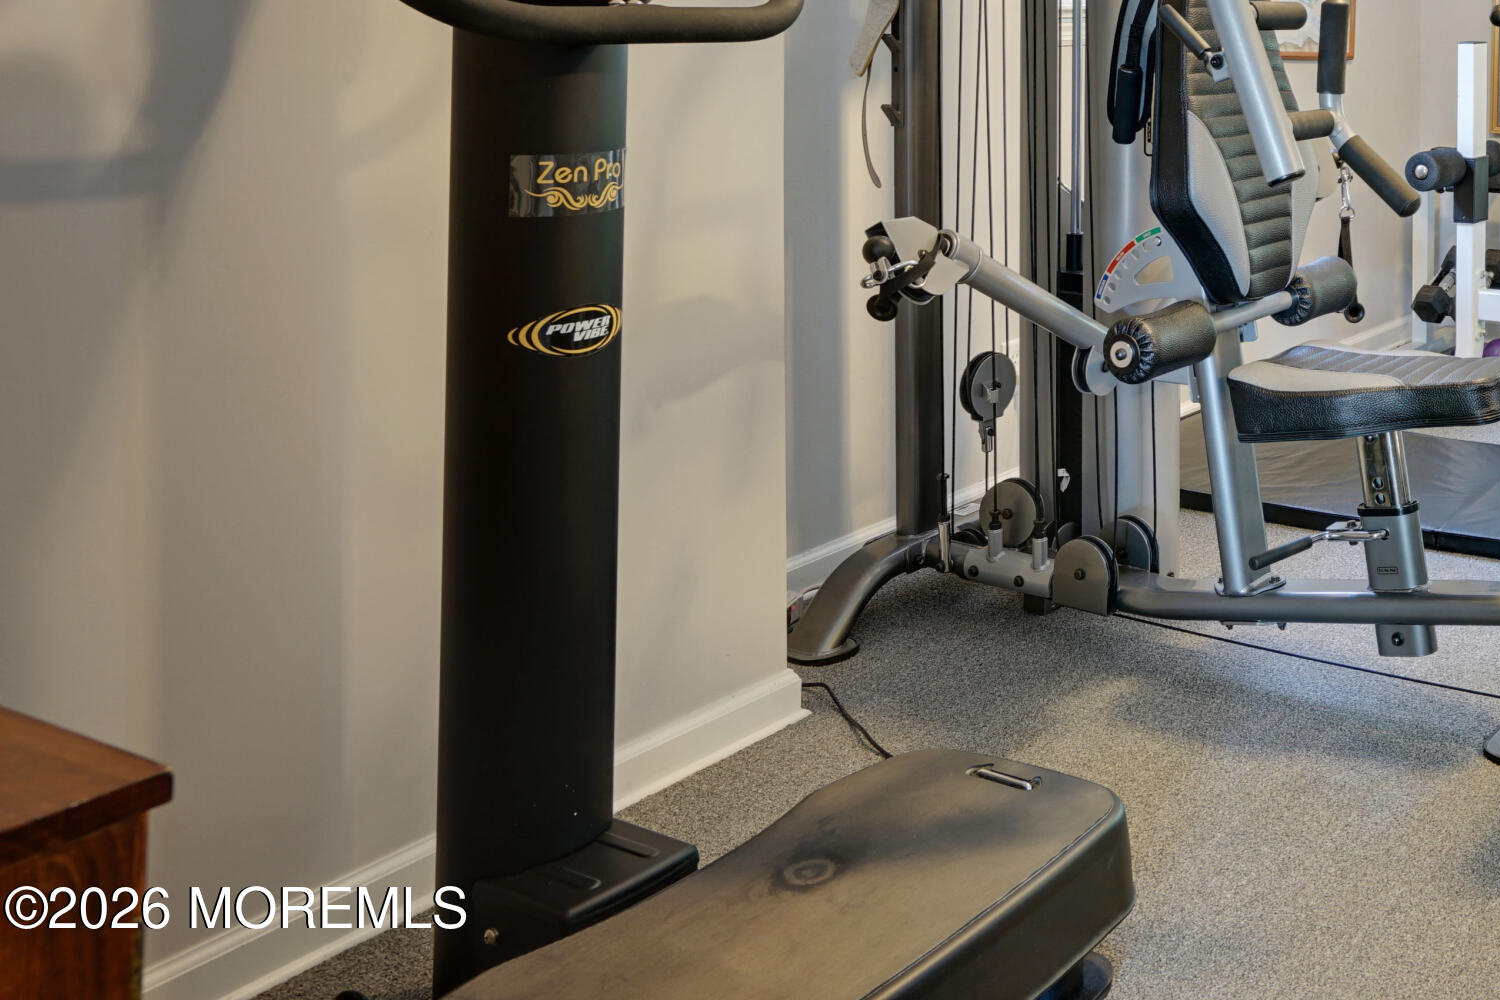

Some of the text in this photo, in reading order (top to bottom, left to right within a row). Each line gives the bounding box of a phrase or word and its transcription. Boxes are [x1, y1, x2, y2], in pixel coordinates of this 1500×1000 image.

[536, 158, 621, 184] Zen Pro
[546, 314, 611, 336] POWER
[573, 327, 609, 342] VIBE
